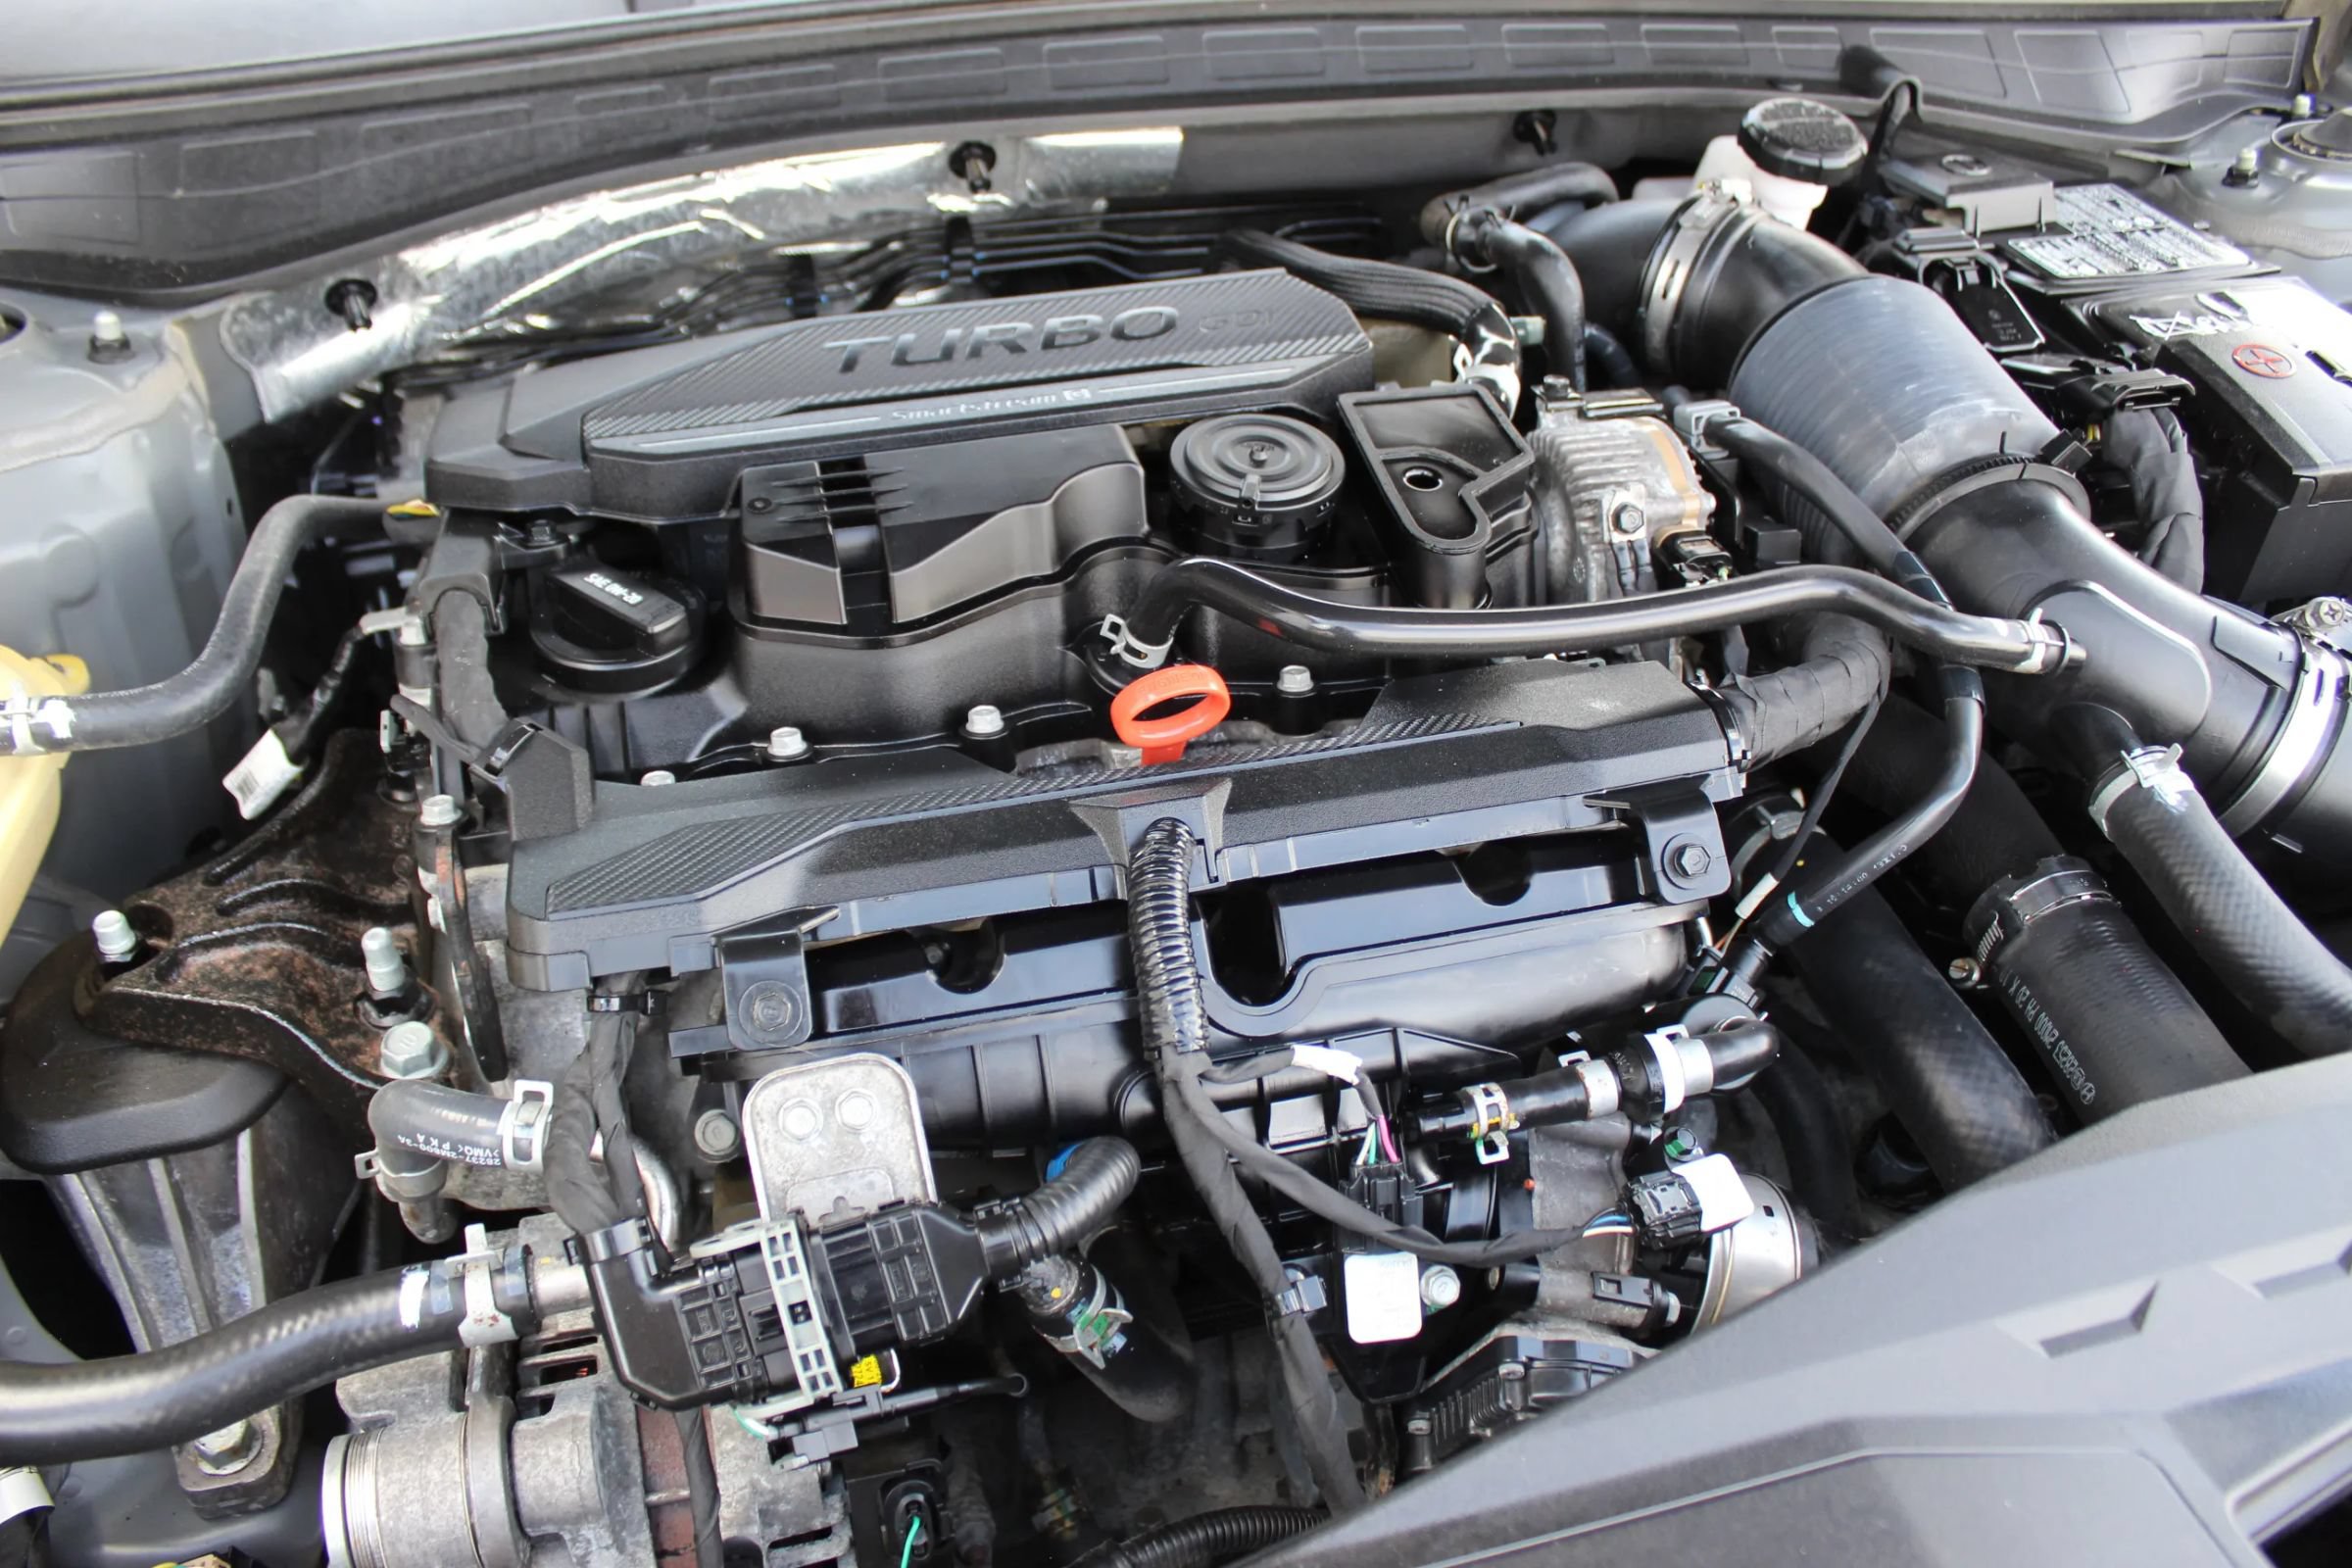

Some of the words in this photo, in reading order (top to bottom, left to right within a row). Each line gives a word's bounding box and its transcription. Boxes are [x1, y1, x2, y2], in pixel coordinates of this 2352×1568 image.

[824, 306, 1179, 373] TURBO
[892, 394, 1056, 419] Smartstream
[583, 573, 612, 588] SAE
